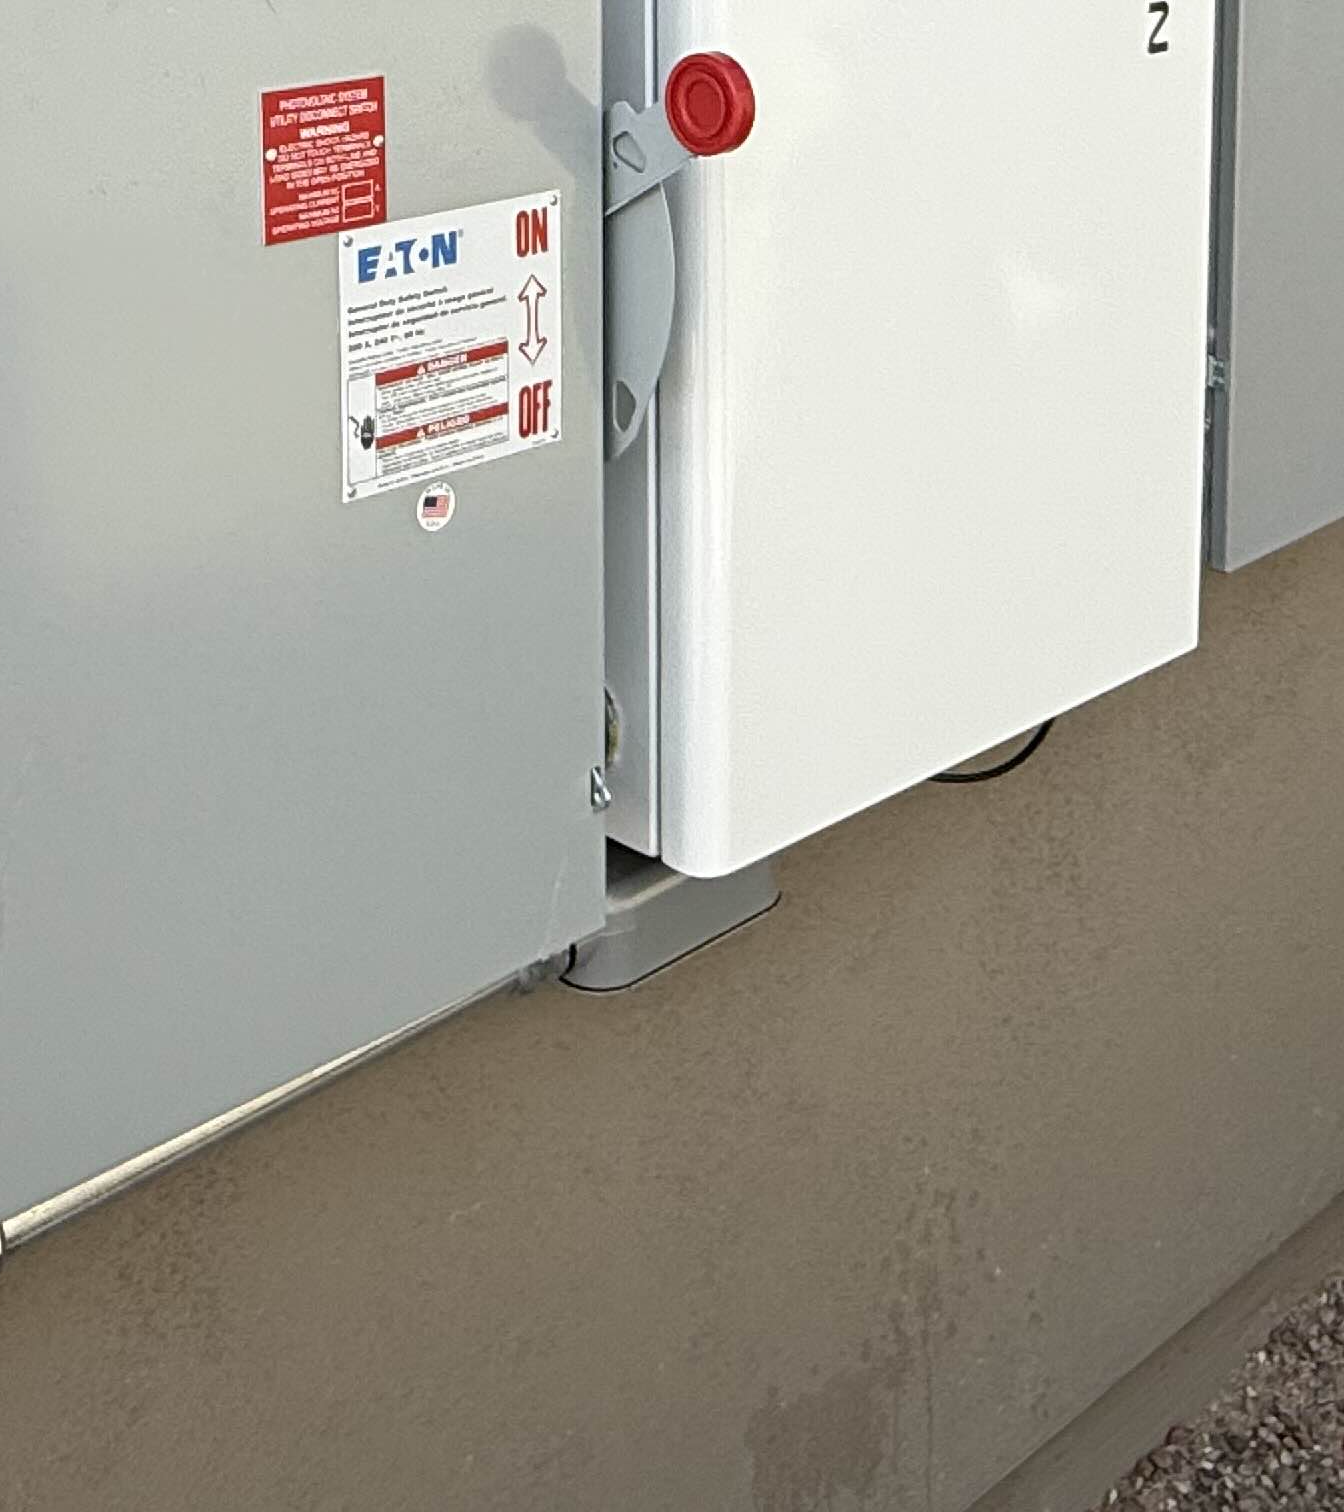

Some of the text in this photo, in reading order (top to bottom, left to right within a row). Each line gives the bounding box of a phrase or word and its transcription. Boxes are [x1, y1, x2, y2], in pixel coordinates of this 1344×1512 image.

[358, 230, 458, 284] EATON
[516, 206, 549, 258] ON
[518, 379, 553, 438] OFF
